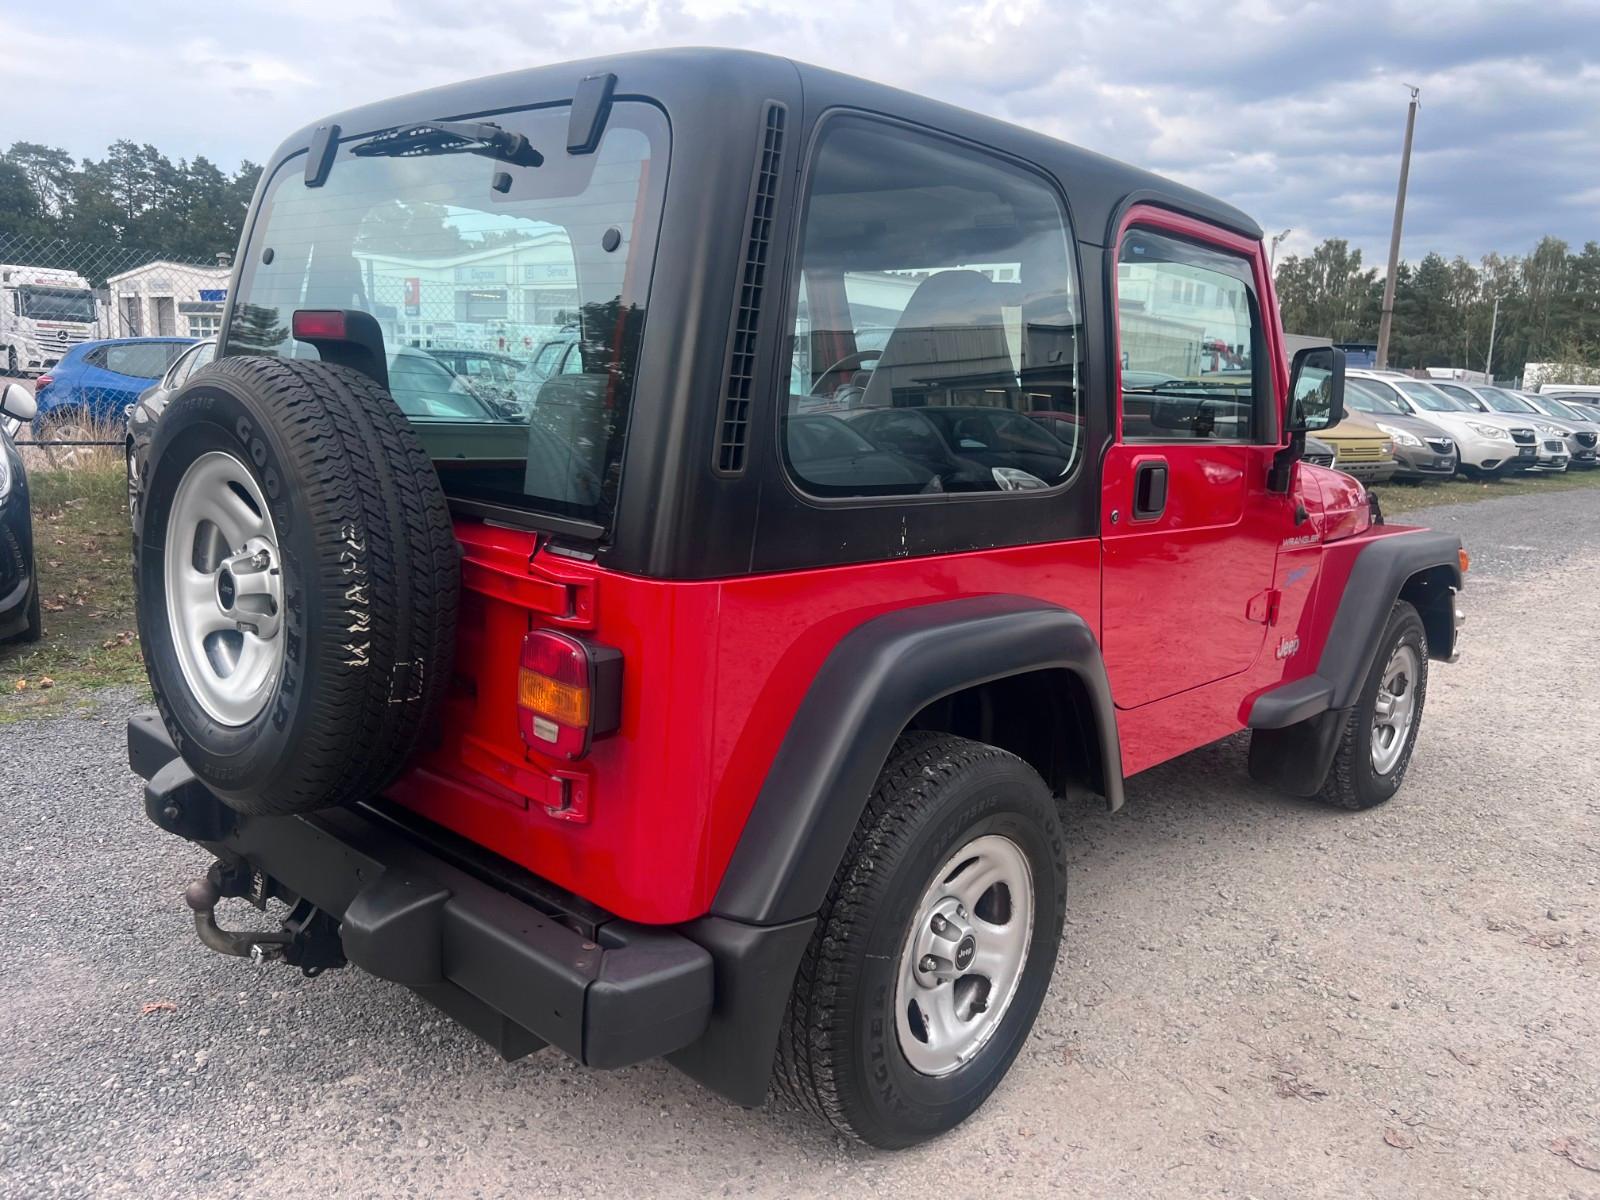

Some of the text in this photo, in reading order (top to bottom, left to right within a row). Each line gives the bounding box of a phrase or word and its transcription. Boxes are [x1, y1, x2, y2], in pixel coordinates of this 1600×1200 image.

[1282, 534, 1319, 547] WRANGLER
[1276, 637, 1299, 658] Jeep
[958, 947, 973, 959] Jeep
